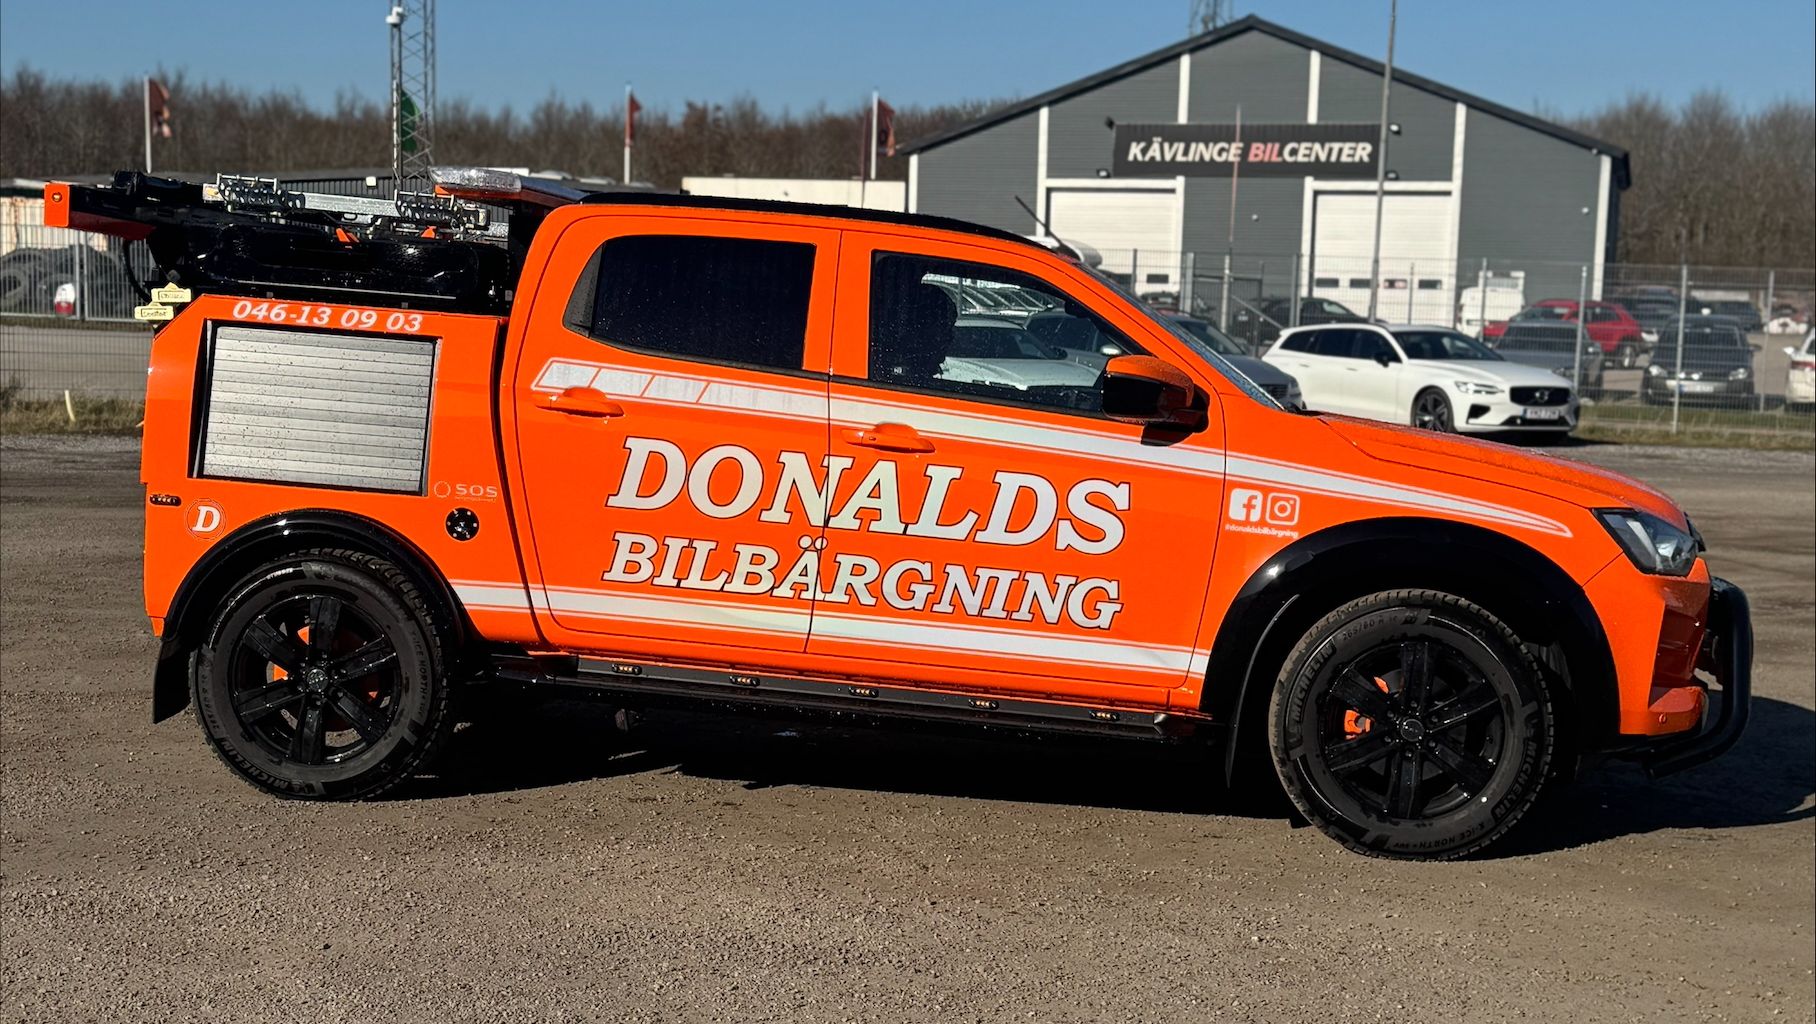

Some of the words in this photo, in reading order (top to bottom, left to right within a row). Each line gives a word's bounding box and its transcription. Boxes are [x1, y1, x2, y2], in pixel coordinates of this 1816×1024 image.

[1127, 137, 1243, 162] KÄVLINGE
[1247, 142, 1373, 162] BILCENTER
[232, 300, 332, 325] 046-13
[340, 309, 378, 328] 09
[386, 312, 423, 332] 03
[455, 483, 498, 498] SOS
[605, 436, 1131, 555] DONALDS
[191, 505, 221, 532] D
[602, 532, 1122, 630] BILBÄRGNING
[1290, 639, 1334, 724] MICHELIN
[219, 740, 290, 790] MICHELIN
[1493, 740, 1538, 819] MICHELIN
